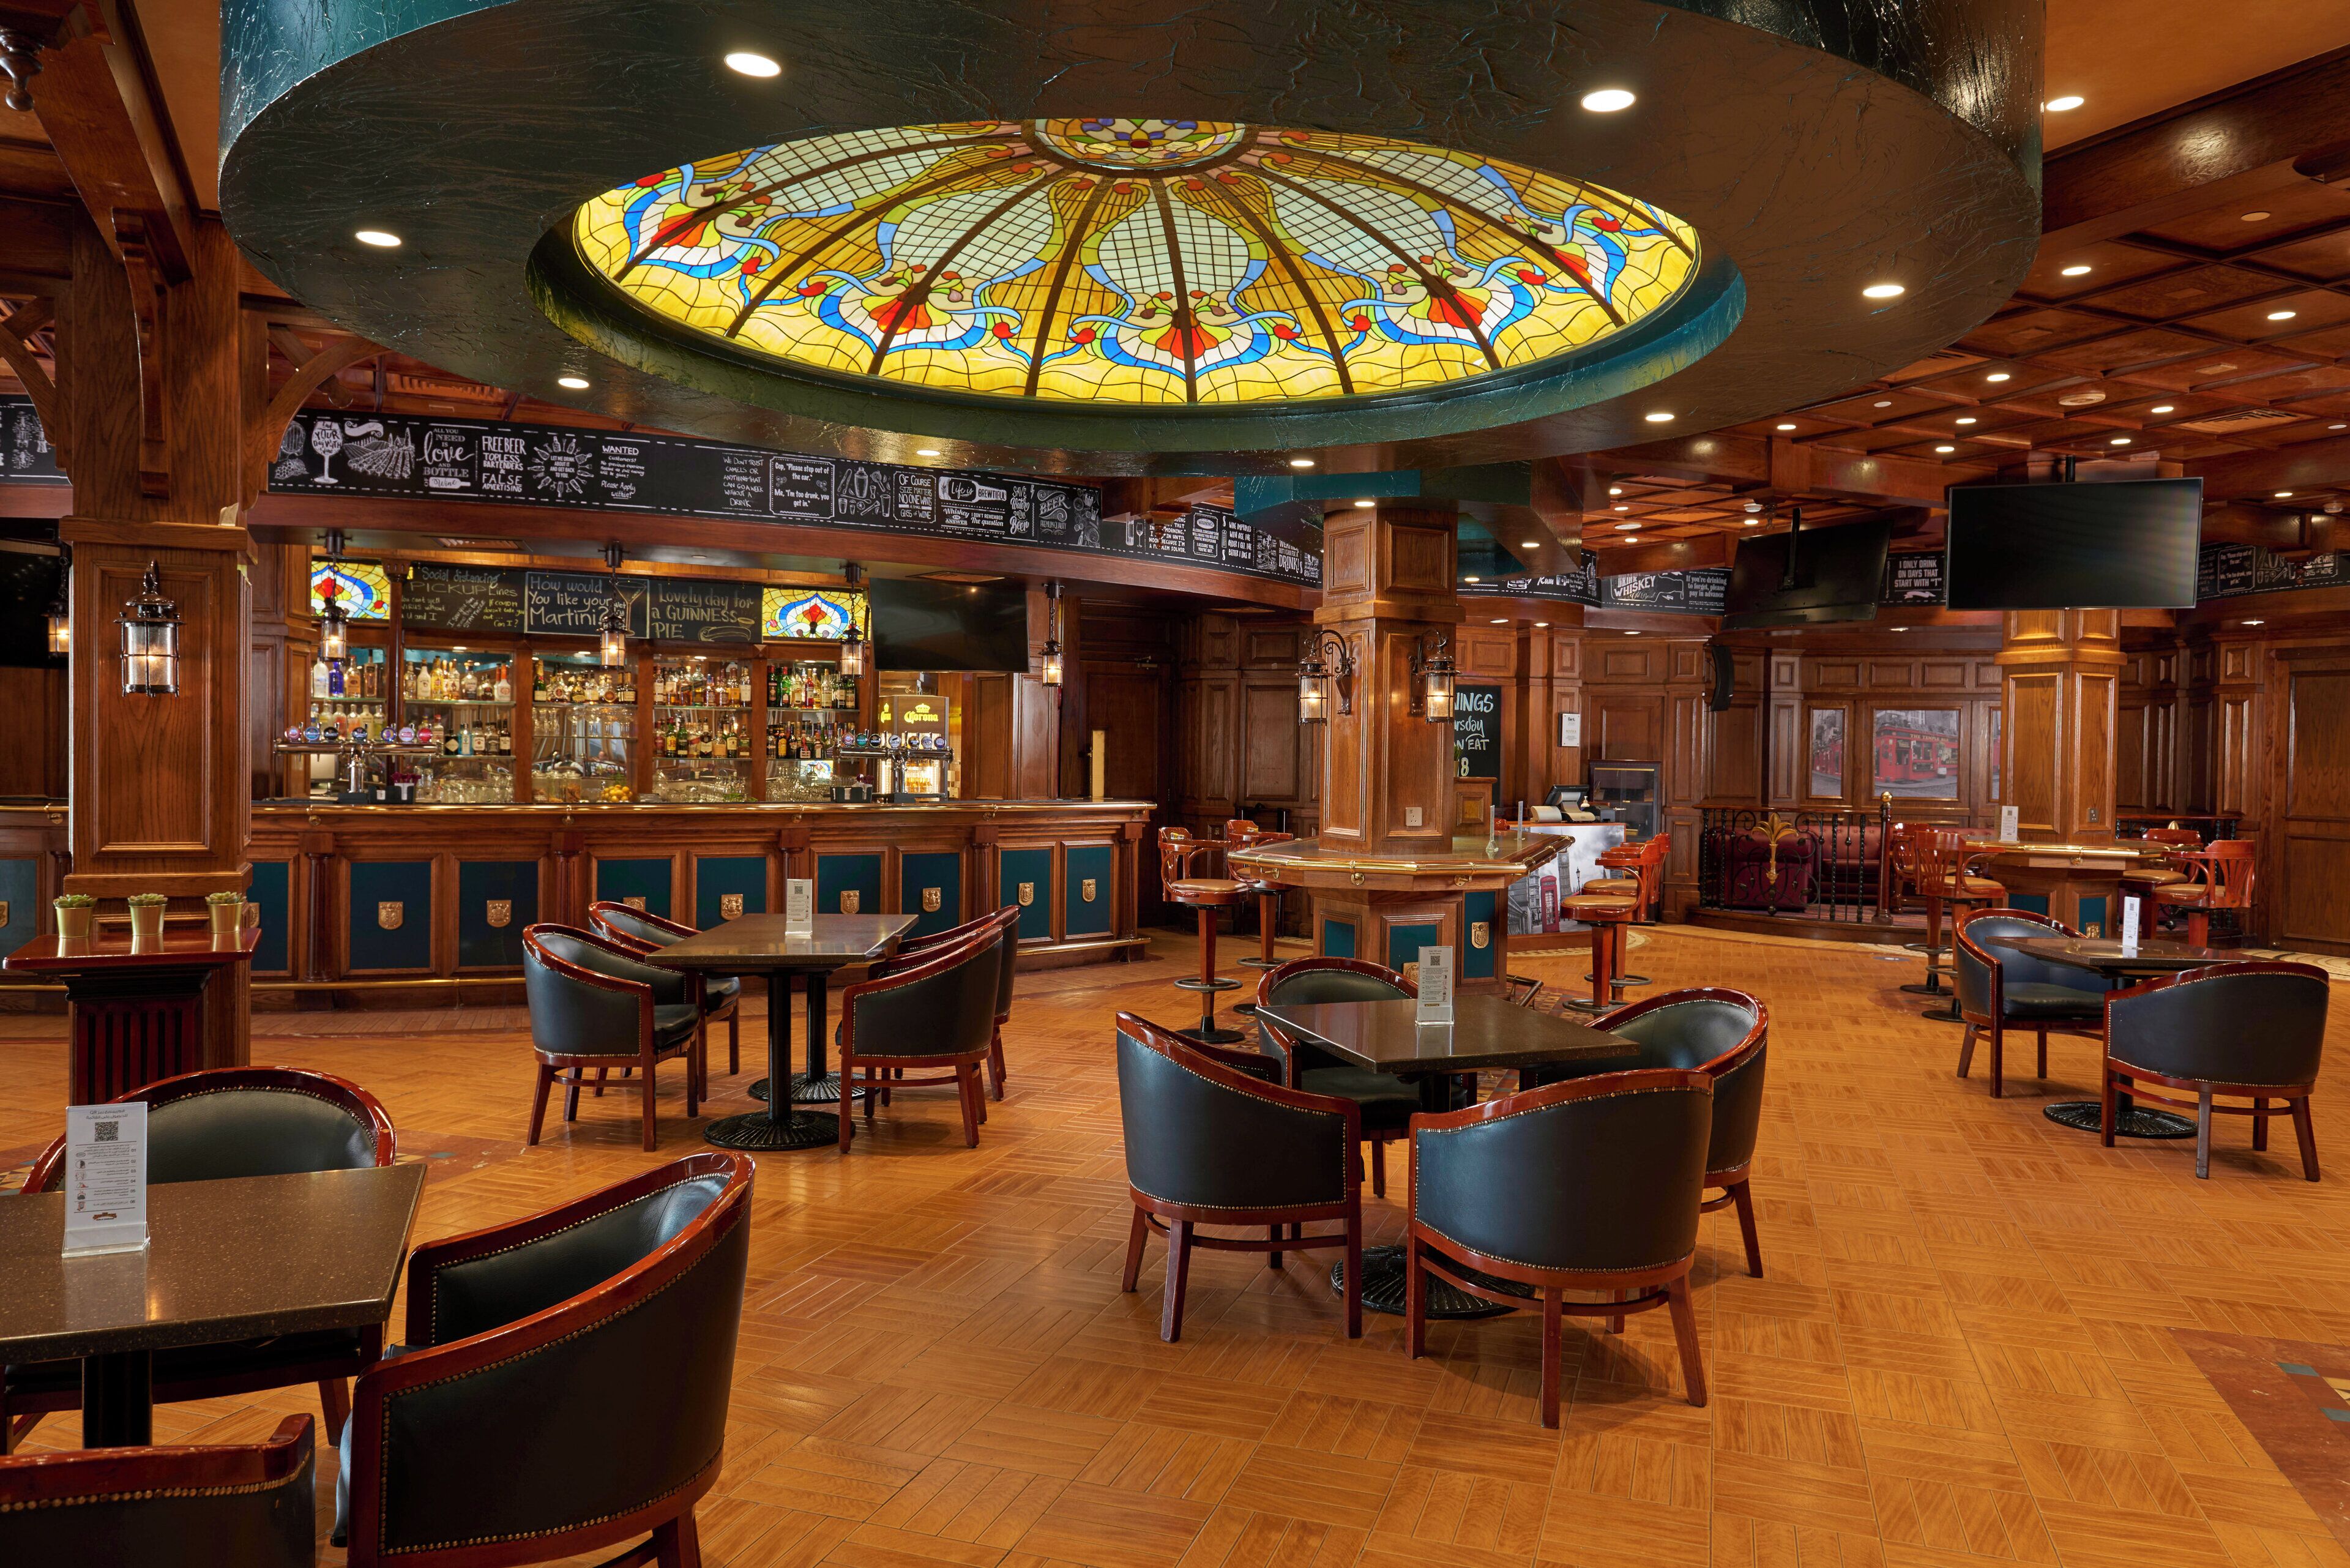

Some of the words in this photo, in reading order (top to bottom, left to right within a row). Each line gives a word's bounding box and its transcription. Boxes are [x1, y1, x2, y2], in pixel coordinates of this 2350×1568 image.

[315, 429, 340, 440] YOUR
[417, 431, 474, 465] love
[482, 436, 504, 452] FREE
[504, 438, 526, 455] BEER
[602, 445, 639, 455] WANTED
[483, 453, 520, 463] TOPLESS
[483, 460, 523, 471] BARTENDERS
[423, 467, 469, 477] BOTTLE
[431, 478, 457, 487] Wine
[482, 473, 523, 485] FALSE
[899, 474, 909, 485] OF
[911, 474, 931, 487] COURSE
[482, 483, 522, 492] ADVERTISING
[620, 482, 636, 494] Apply
[914, 488, 932, 496] MATTERS
[952, 482, 965, 499] Life
[966, 486, 974, 495] is
[1012, 486, 1027, 499] SAVE
[774, 488, 785, 497] Me,
[805, 491, 820, 500] drunk,
[899, 493, 908, 504] NO
[909, 495, 921, 505] ONE
[979, 488, 1007, 501] BREWTIFUL
[729, 498, 752, 507] DRINK
[1010, 497, 1029, 512] Water
[1039, 494, 1071, 515] BEER
[918, 510, 931, 519] WINE
[943, 508, 969, 518] Whiskey
[1010, 516, 1029, 534] Beer
[1237, 523, 1251, 532] IMPROVES
[1279, 554, 1299, 573] DRINK!
[1903, 560, 1917, 569] ONLY
[1919, 559, 1937, 569] DRINK
[422, 567, 449, 581] Social
[453, 569, 501, 588] distancing
[1898, 570, 1906, 578] ON
[1908, 569, 1922, 578] DAYS
[1923, 569, 1938, 577] THAT
[531, 576, 561, 591] How
[567, 579, 602, 594] would
[1614, 575, 1655, 597] WHISKEY
[1894, 579, 1912, 588] START
[1913, 578, 1930, 587] WITH
[488, 587, 518, 597] Lines
[658, 584, 702, 607] Lovely
[705, 588, 729, 610] day
[733, 589, 754, 608] for
[529, 591, 550, 604] You
[558, 592, 578, 605] like
[583, 597, 613, 613] your
[429, 612, 437, 621] I
[530, 606, 609, 625] Martini?
[651, 607, 661, 619] a
[666, 605, 737, 623] GUINNESS
[652, 622, 684, 638] PIE
[904, 711, 938, 724] Corona
[1453, 739, 1464, 750] N
[1468, 738, 1490, 750] EAT
